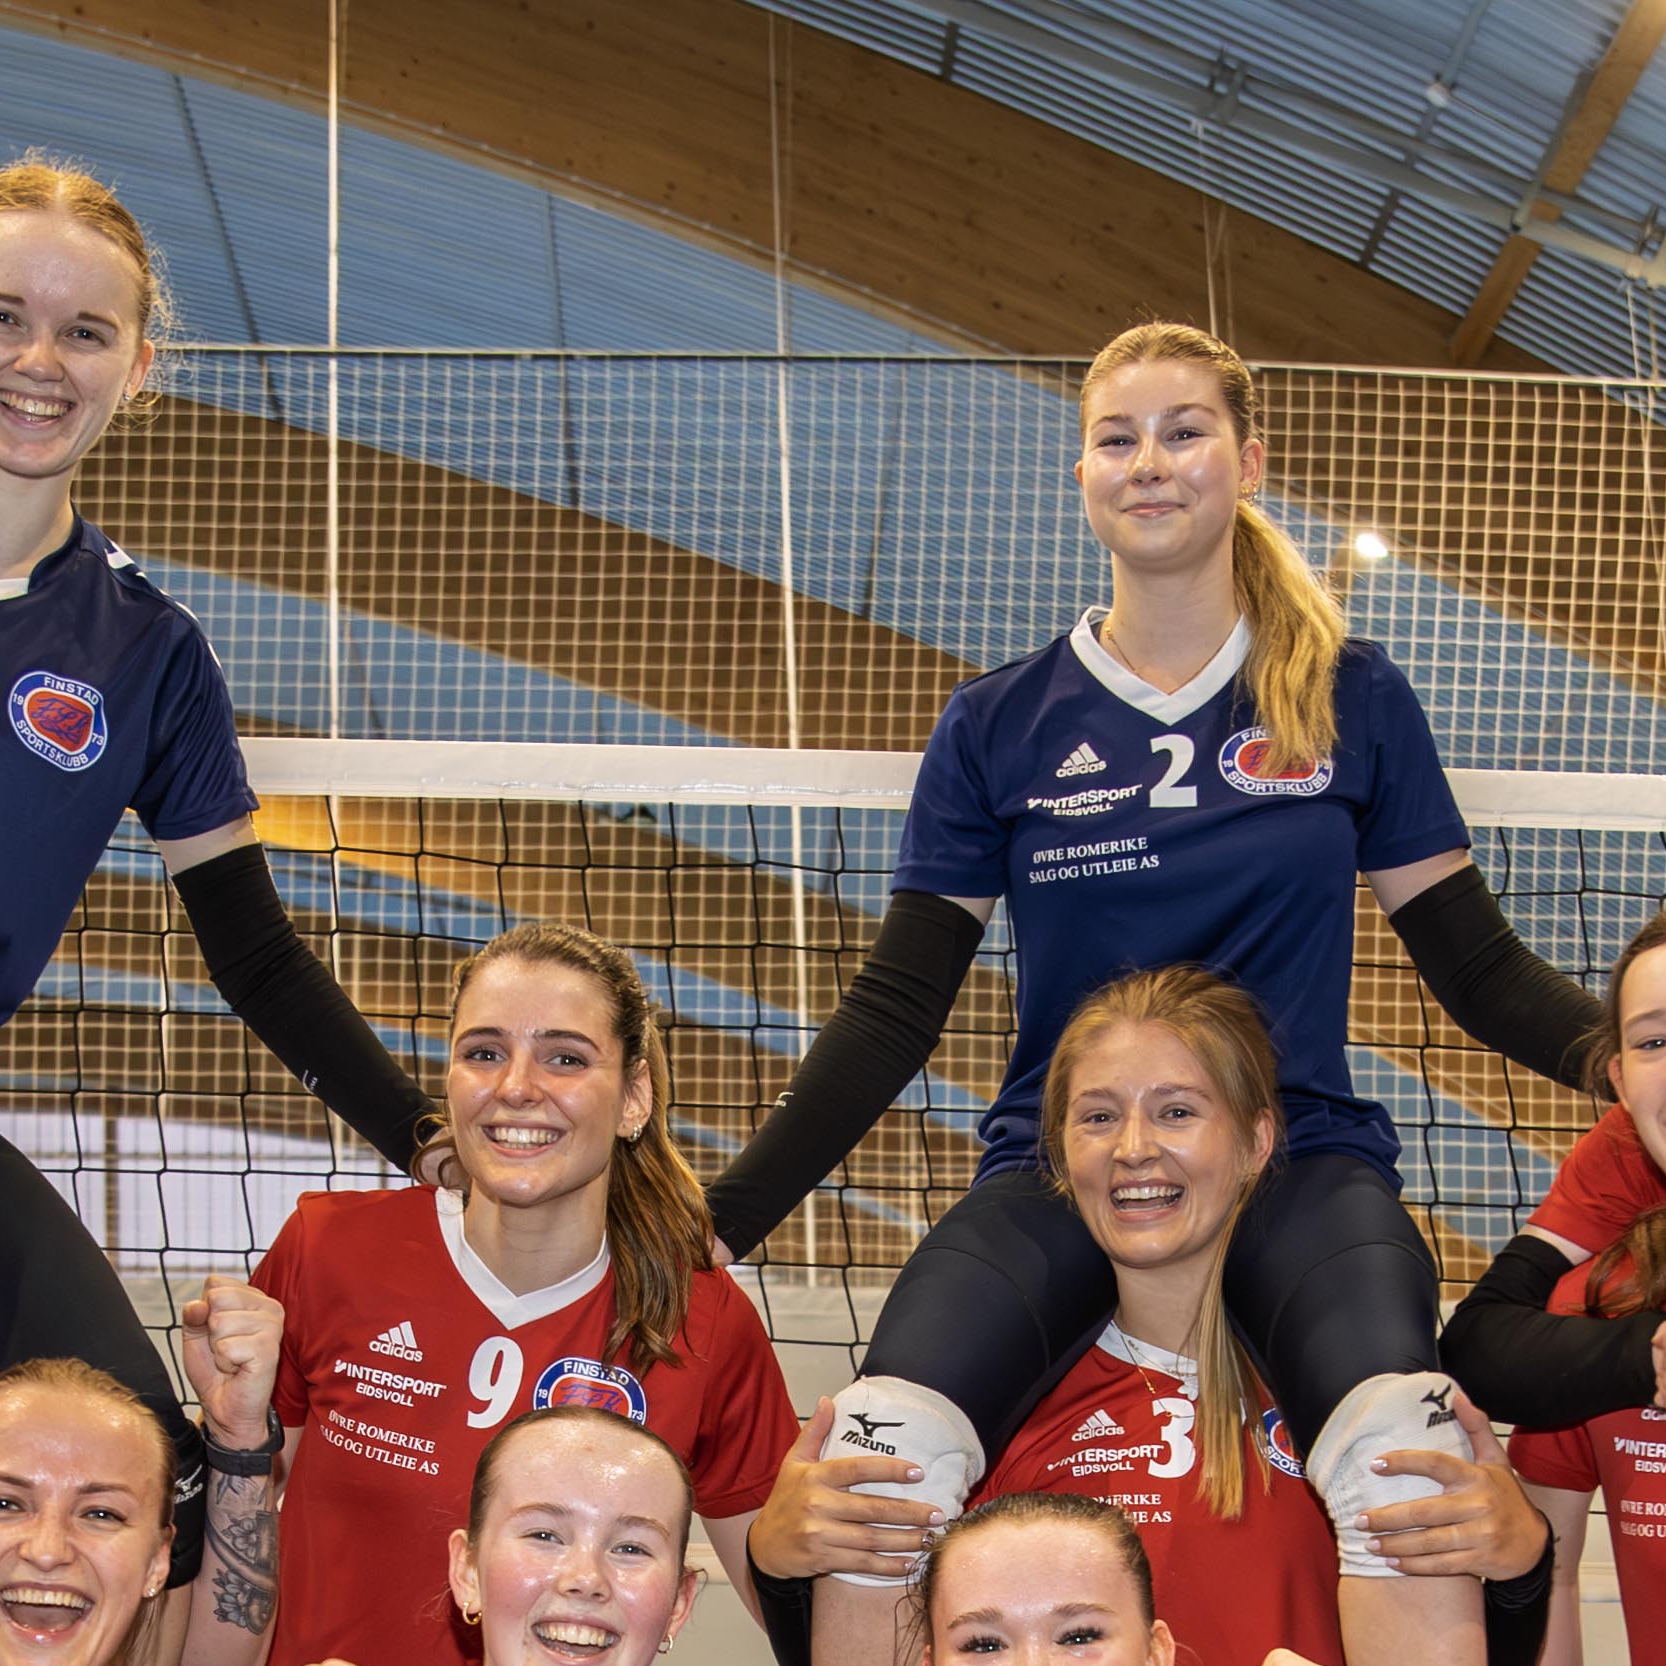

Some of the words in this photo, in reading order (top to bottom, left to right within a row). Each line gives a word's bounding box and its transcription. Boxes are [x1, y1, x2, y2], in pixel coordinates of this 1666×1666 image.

[13, 693, 24, 706] 19
[44, 676, 99, 706] FINSTAD
[17, 719, 89, 767] SPORTSKLUBB
[91, 732, 104, 746] 73
[1056, 760, 1107, 778] adidas
[1149, 734, 1197, 808] 2
[1222, 760, 1233, 768] 19
[1228, 771, 1328, 793] SPORTSKLUBB
[1041, 784, 1143, 809] INTERSPORT
[1052, 803, 1114, 816] EIDSVOLL
[1033, 848, 1064, 864] ØVRE
[1066, 837, 1148, 860] ROMERIKE
[1029, 869, 1056, 884] SALG
[1058, 866, 1079, 879] OG
[1082, 858, 1137, 877] UTLEIE
[1139, 855, 1159, 869] AS
[368, 1340, 424, 1362] adidas
[346, 1363, 447, 1398] INTERSPORT
[467, 1336, 523, 1429] 9
[355, 1382, 414, 1407] EIDSVOLL
[538, 1389, 548, 1398] 19
[632, 1410, 644, 1420] 73
[356, 1422, 436, 1454] ROMERIKE
[1071, 1424, 1125, 1443] adidas
[344, 1439, 363, 1455] OG
[365, 1445, 417, 1470] UTLEIE
[419, 1460, 440, 1476] AS
[1059, 1444, 1164, 1467] INTERSPORT
[1072, 1461, 1134, 1477] EIDSVOLL
[1092, 1494, 1162, 1507] MERIKE
[1151, 1510, 1172, 1523] AS
[1637, 1523, 1654, 1537] OG
